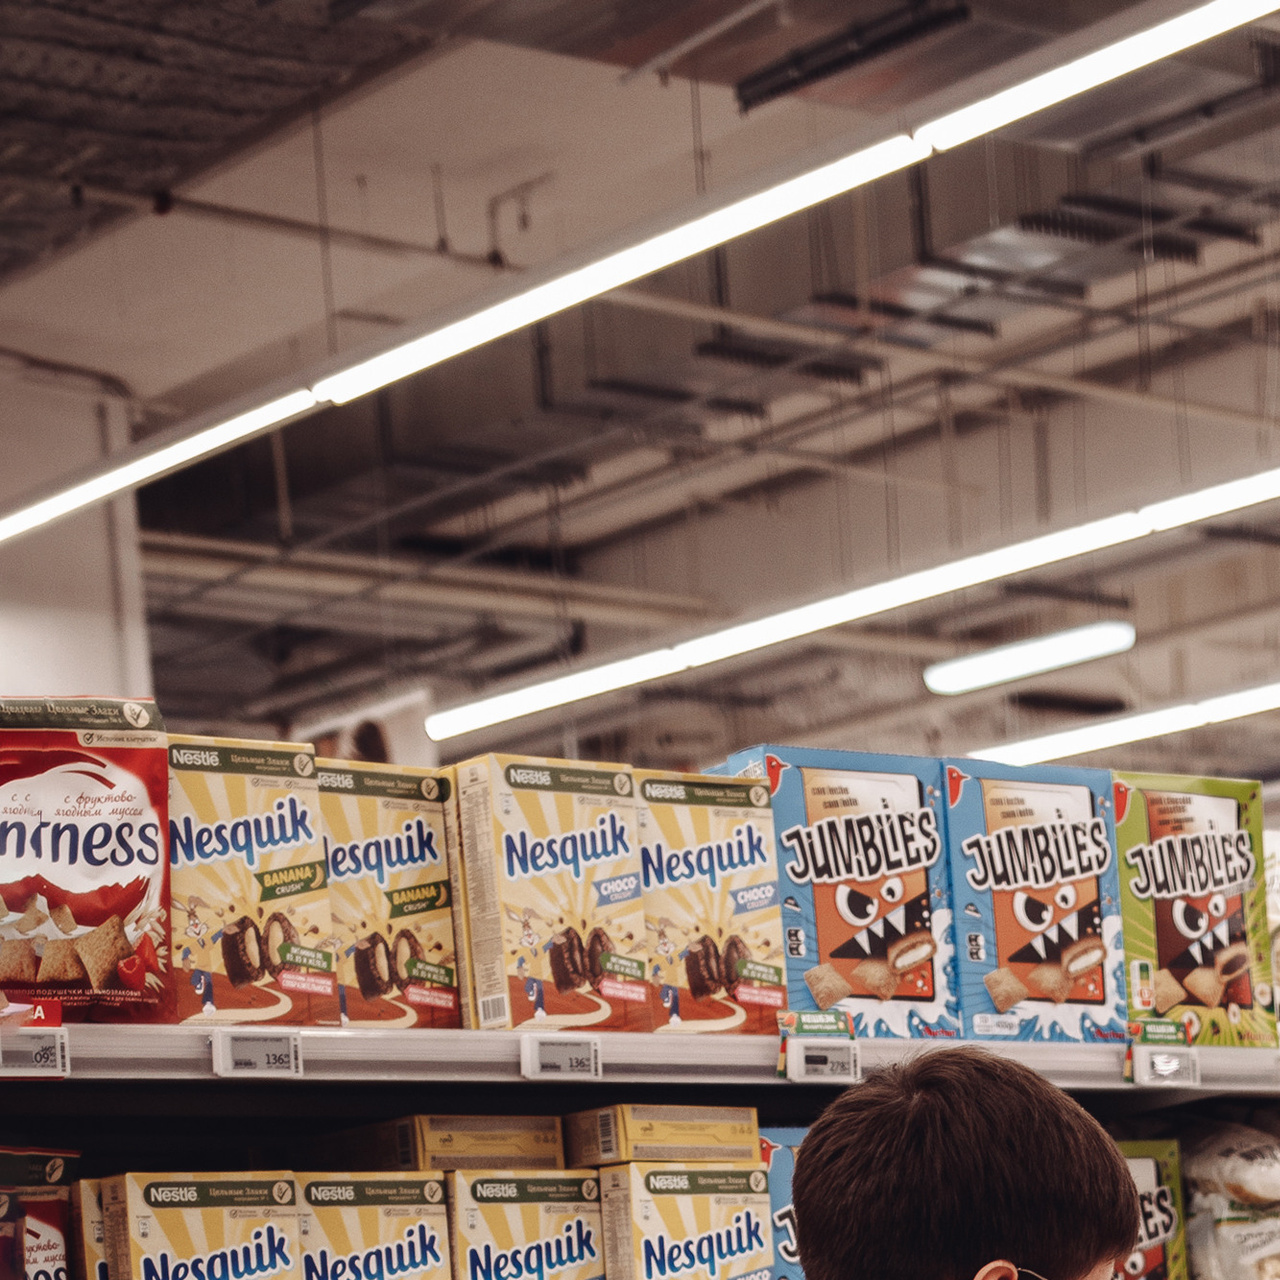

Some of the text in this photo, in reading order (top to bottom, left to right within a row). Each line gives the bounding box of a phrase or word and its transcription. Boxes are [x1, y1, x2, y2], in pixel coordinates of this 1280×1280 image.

[169, 797, 313, 866] Nesquik
[505, 813, 629, 878] Nesquik
[641, 824, 767, 889] Nesquik
[643, 1211, 764, 1280] Nesquik
